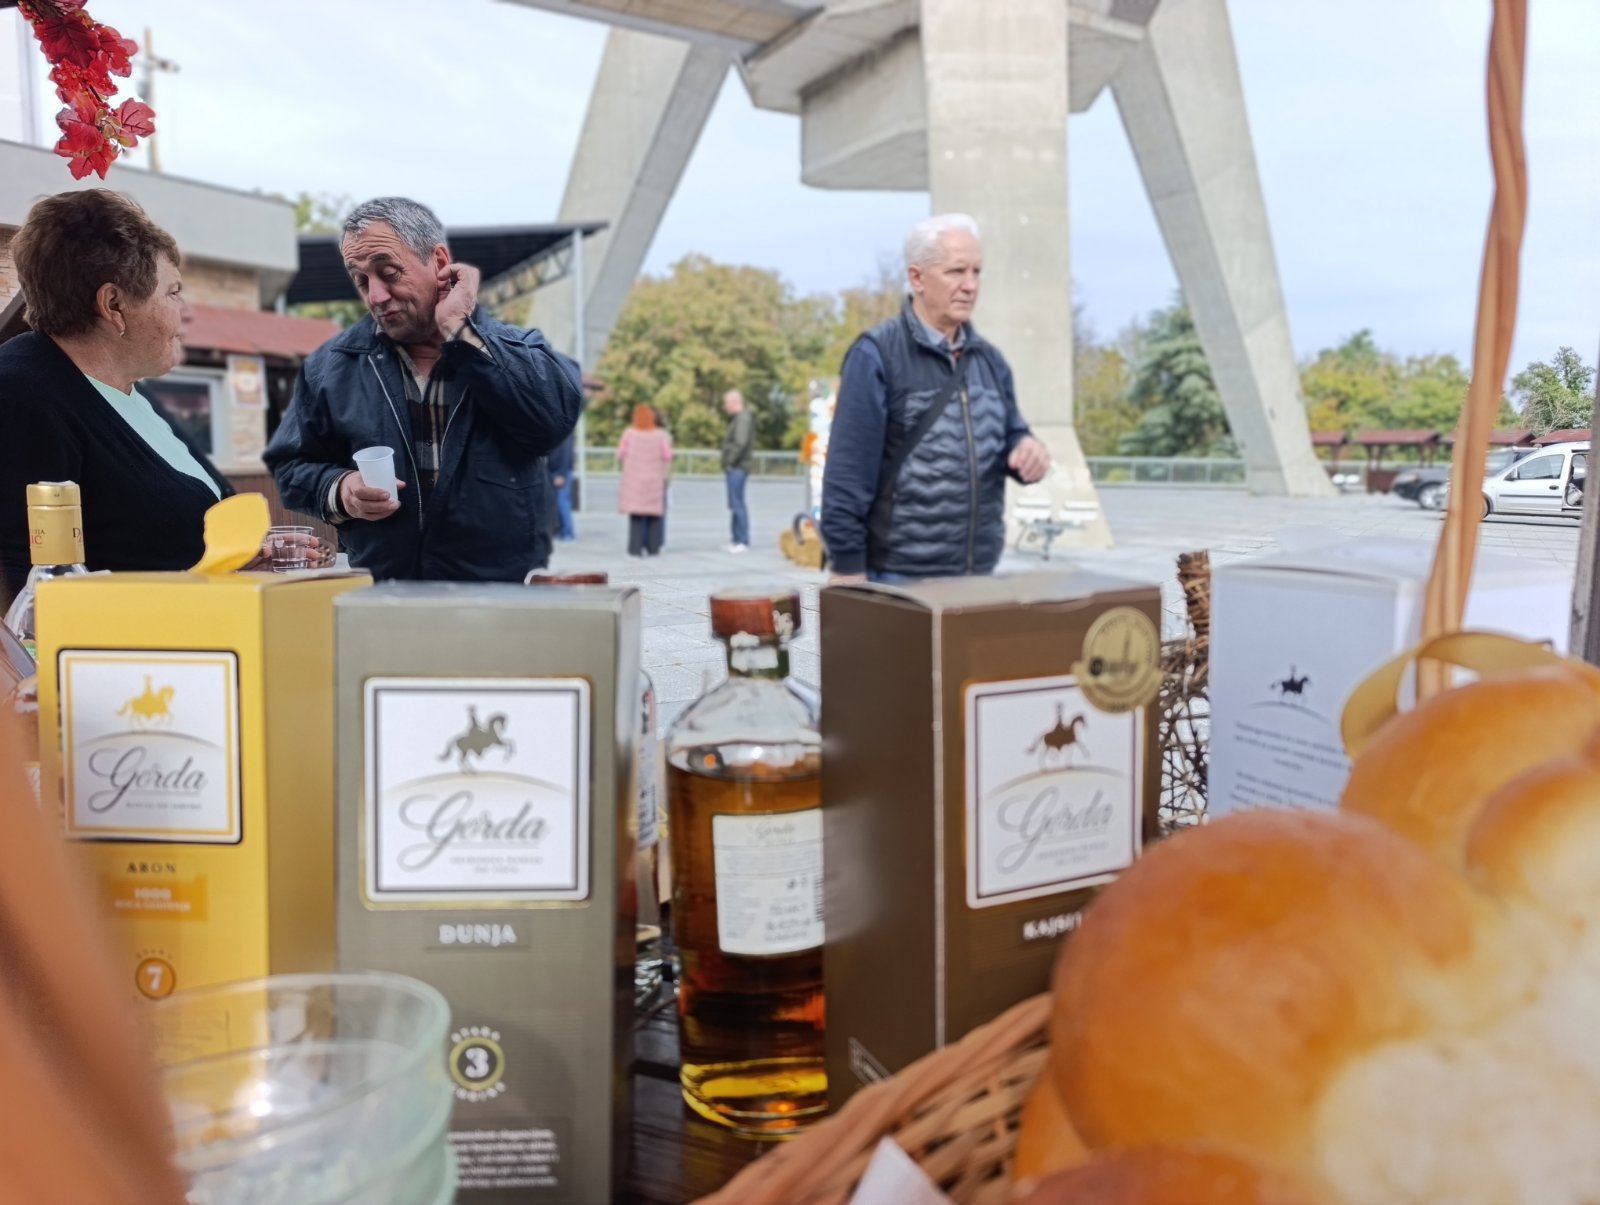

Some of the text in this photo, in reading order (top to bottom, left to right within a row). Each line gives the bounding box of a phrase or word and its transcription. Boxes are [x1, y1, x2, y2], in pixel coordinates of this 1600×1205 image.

[438, 923, 518, 947] DUNJA
[146, 965, 163, 992] 7
[465, 1047, 489, 1078] 3
